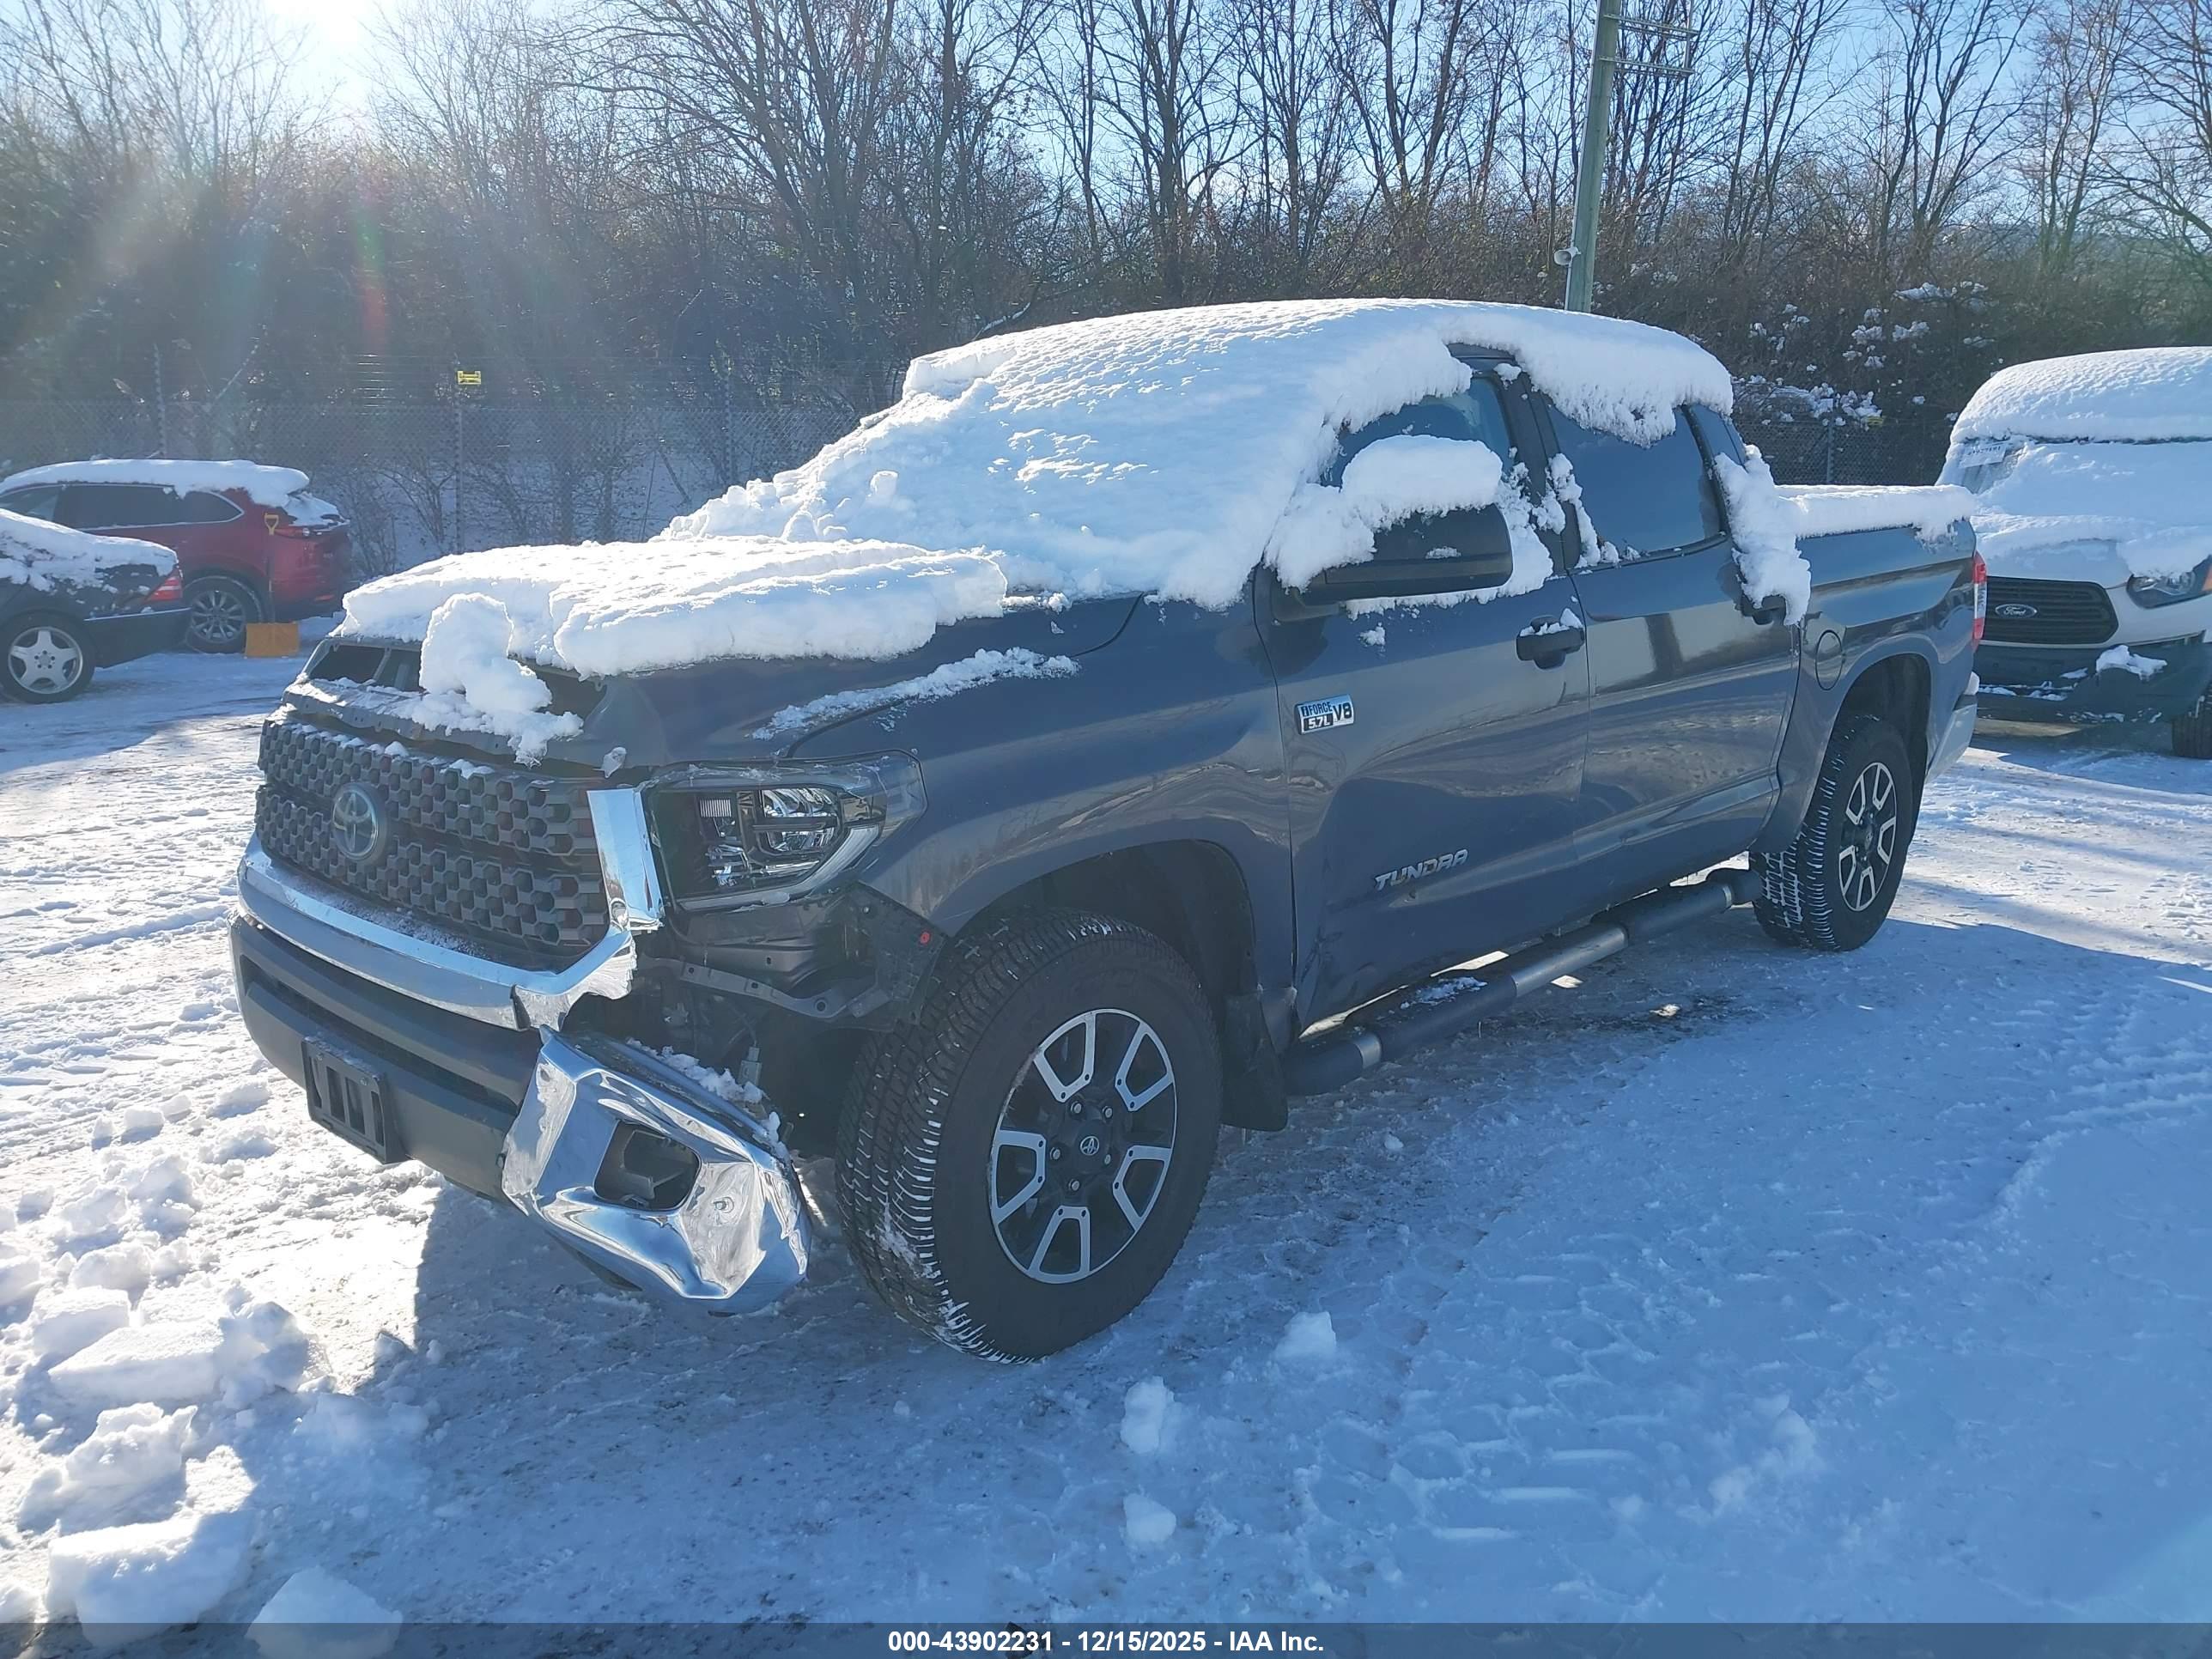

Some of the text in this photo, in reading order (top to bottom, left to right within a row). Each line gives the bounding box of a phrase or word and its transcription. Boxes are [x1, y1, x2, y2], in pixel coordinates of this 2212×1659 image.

[1331, 702, 1352, 721] V8
[1308, 715, 1331, 729] 5.7L
[1375, 848, 1468, 890] TUNDRA
